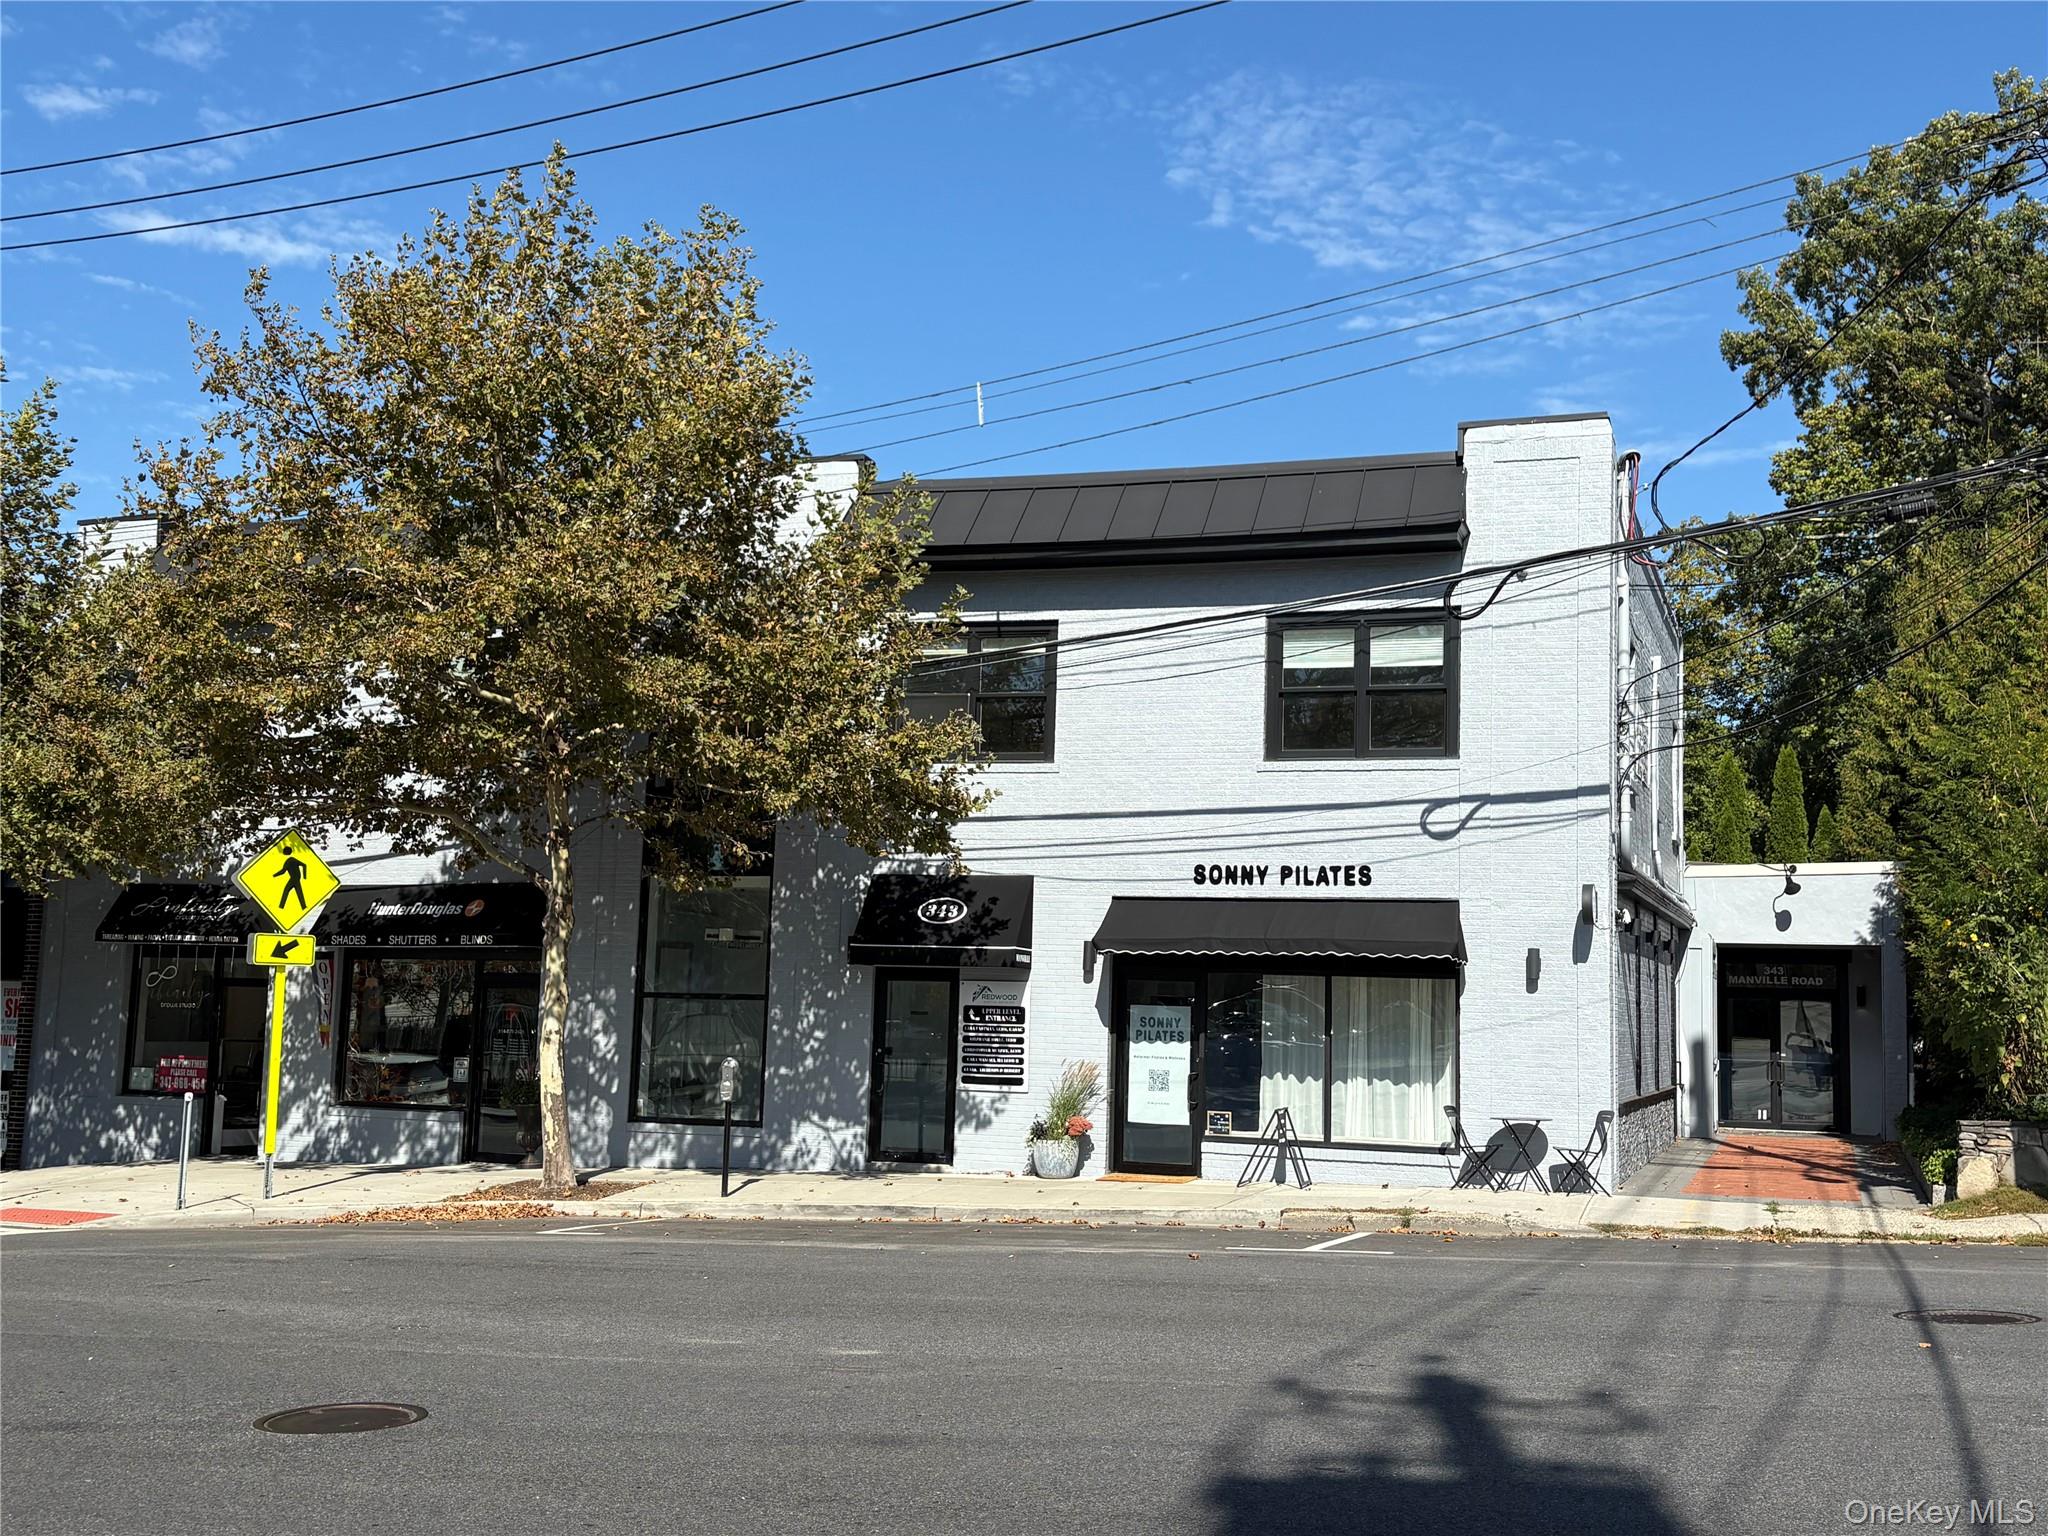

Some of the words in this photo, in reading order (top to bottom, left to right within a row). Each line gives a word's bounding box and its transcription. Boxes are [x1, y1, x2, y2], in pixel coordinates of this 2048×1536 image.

[1193, 864, 1269, 885] SONNY
[1280, 865, 1372, 886] PILATES
[926, 904, 959, 918] 343
[331, 935, 367, 945] SHADES
[388, 935, 437, 945] SHUTTERS
[460, 935, 493, 945] BLINDS
[1763, 966, 1784, 975] 343
[1728, 975, 1788, 985] MANVILLE
[1791, 976, 1824, 986] ROAD
[1140, 1016, 1181, 1028] SONNY
[1135, 1030, 1185, 1041] PILATES
